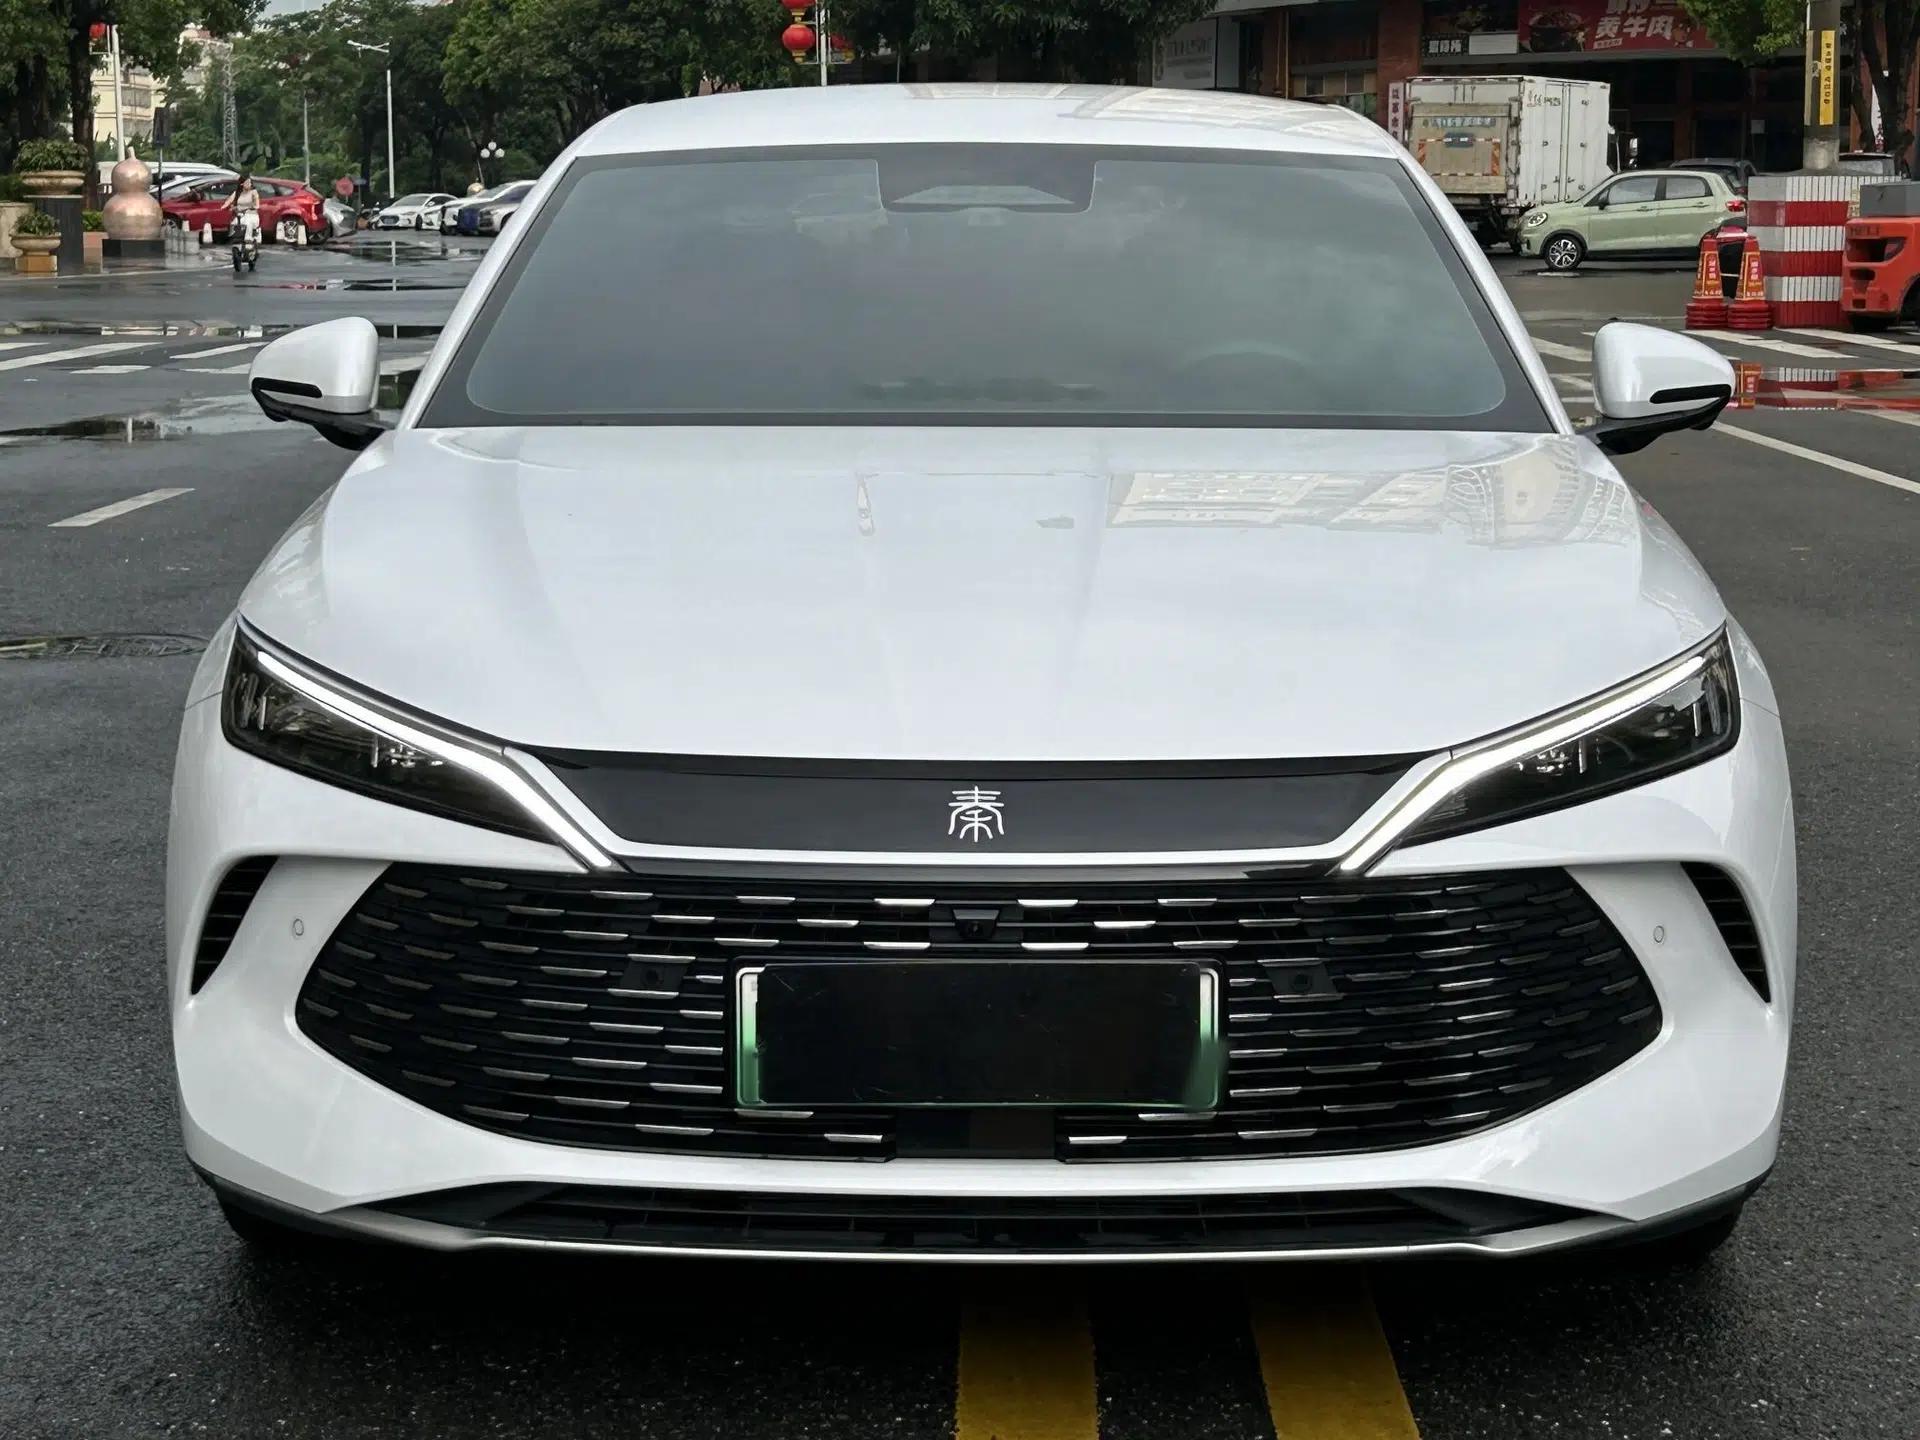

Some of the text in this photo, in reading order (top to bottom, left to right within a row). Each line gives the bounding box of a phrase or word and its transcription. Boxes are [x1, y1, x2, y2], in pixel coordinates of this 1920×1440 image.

[1595, 15, 1674, 40] 黄牛肉
[948, 785, 1005, 842] 秦
